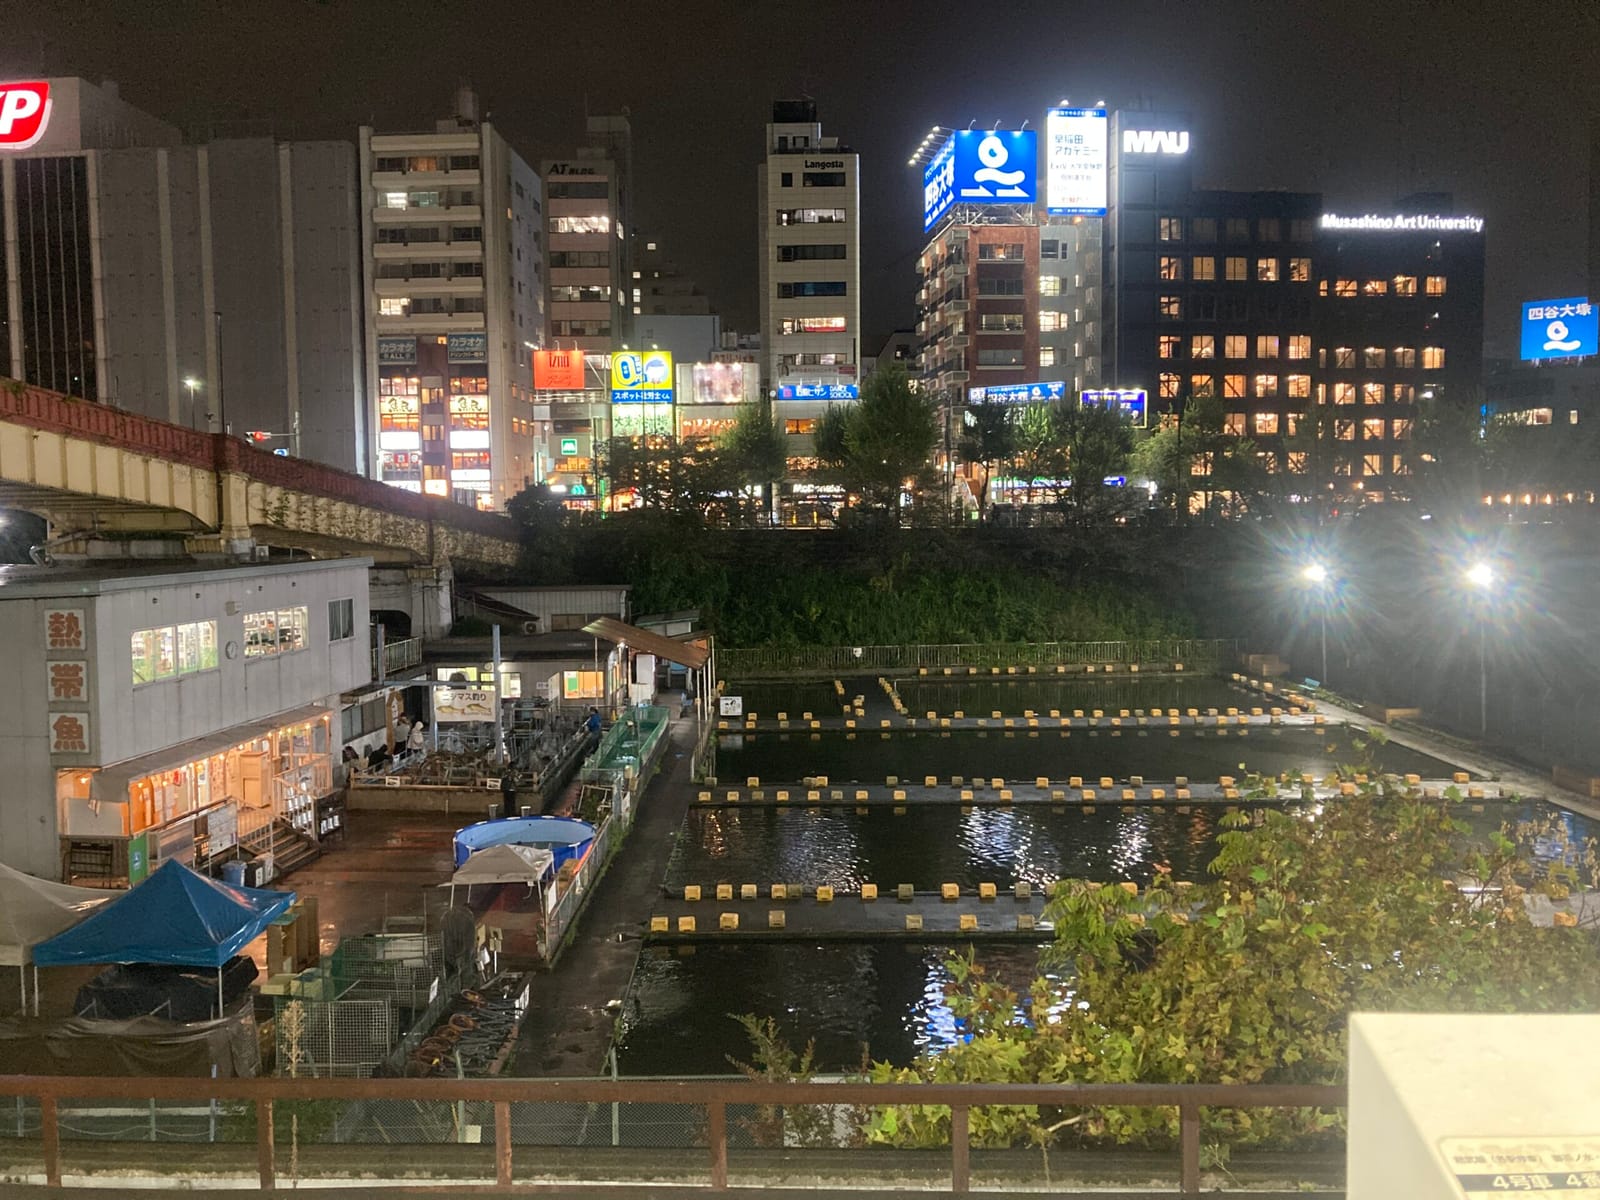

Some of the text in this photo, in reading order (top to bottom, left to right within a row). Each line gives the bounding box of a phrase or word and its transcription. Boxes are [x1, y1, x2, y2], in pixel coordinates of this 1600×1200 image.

[0, 90, 41, 135] P
[1123, 130, 1189, 153] MAU
[1055, 146, 1099, 155] アカデミー
[548, 163, 569, 175] AT
[804, 159, 844, 170] Langosta
[1321, 214, 1483, 232] Musashino Art University
[1528, 303, 1592, 320] 四谷大塚
[380, 343, 414, 352] カラオケ
[450, 337, 483, 347] カラオケ
[442, 692, 487, 701] ニジマス釣り
[1492, 1174, 1553, 1190] 4号車
